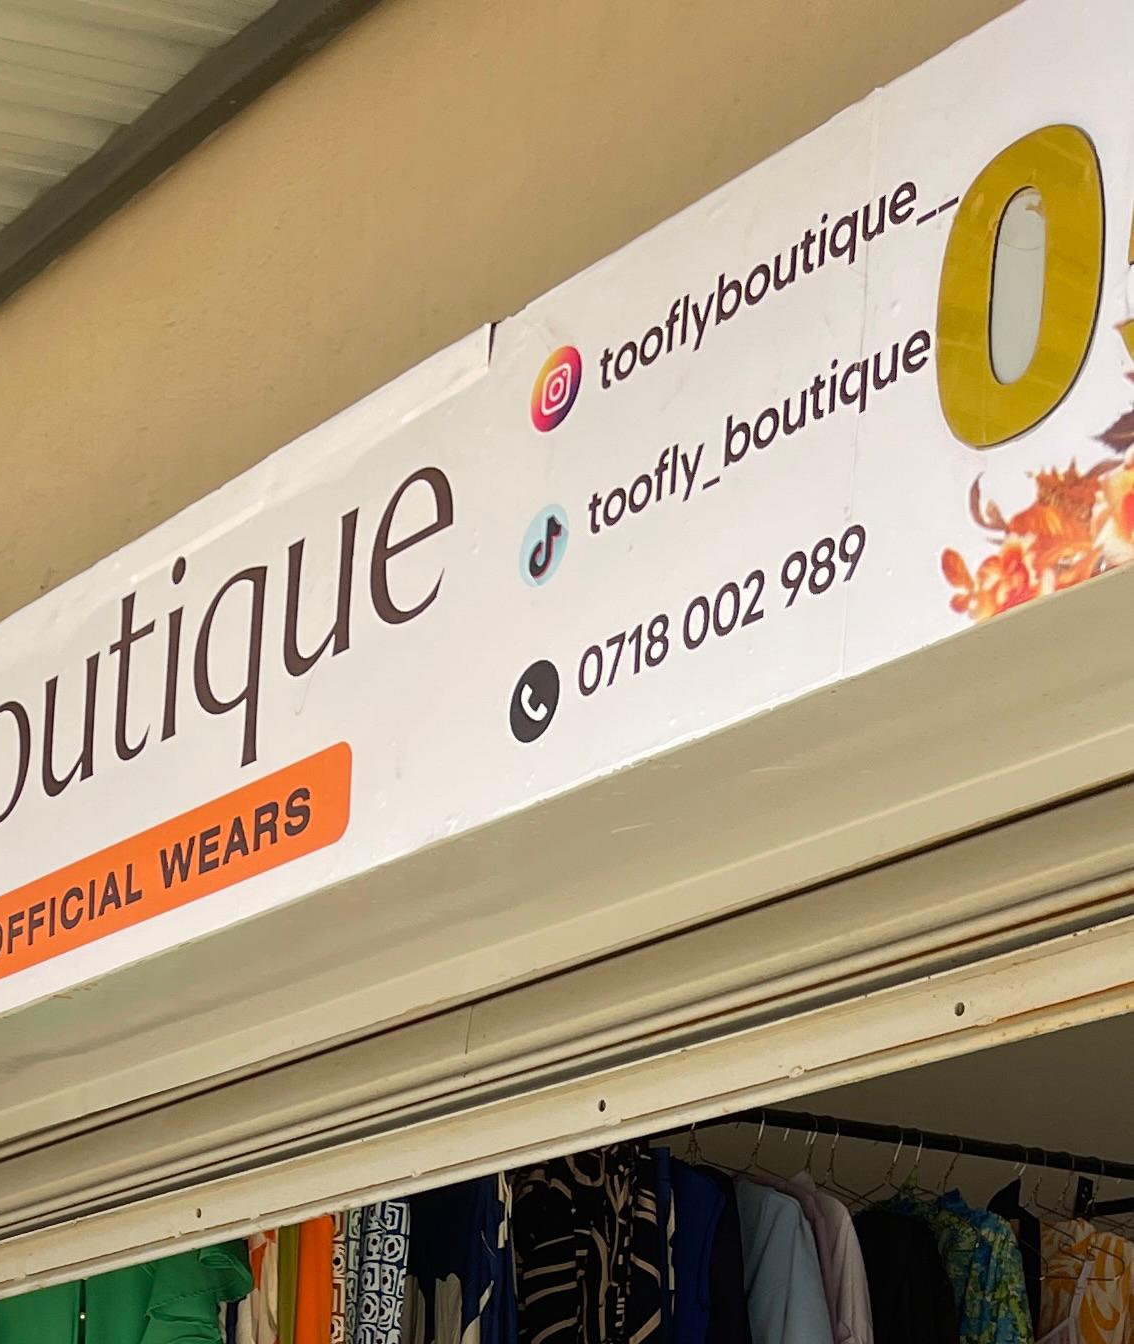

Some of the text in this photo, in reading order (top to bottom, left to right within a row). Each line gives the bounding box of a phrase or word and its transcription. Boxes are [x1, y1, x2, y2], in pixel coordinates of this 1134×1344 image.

[935, 123, 1134, 449] 0
[577, 523, 867, 698] 0718 002 989
[160, 786, 311, 888] WEARS
